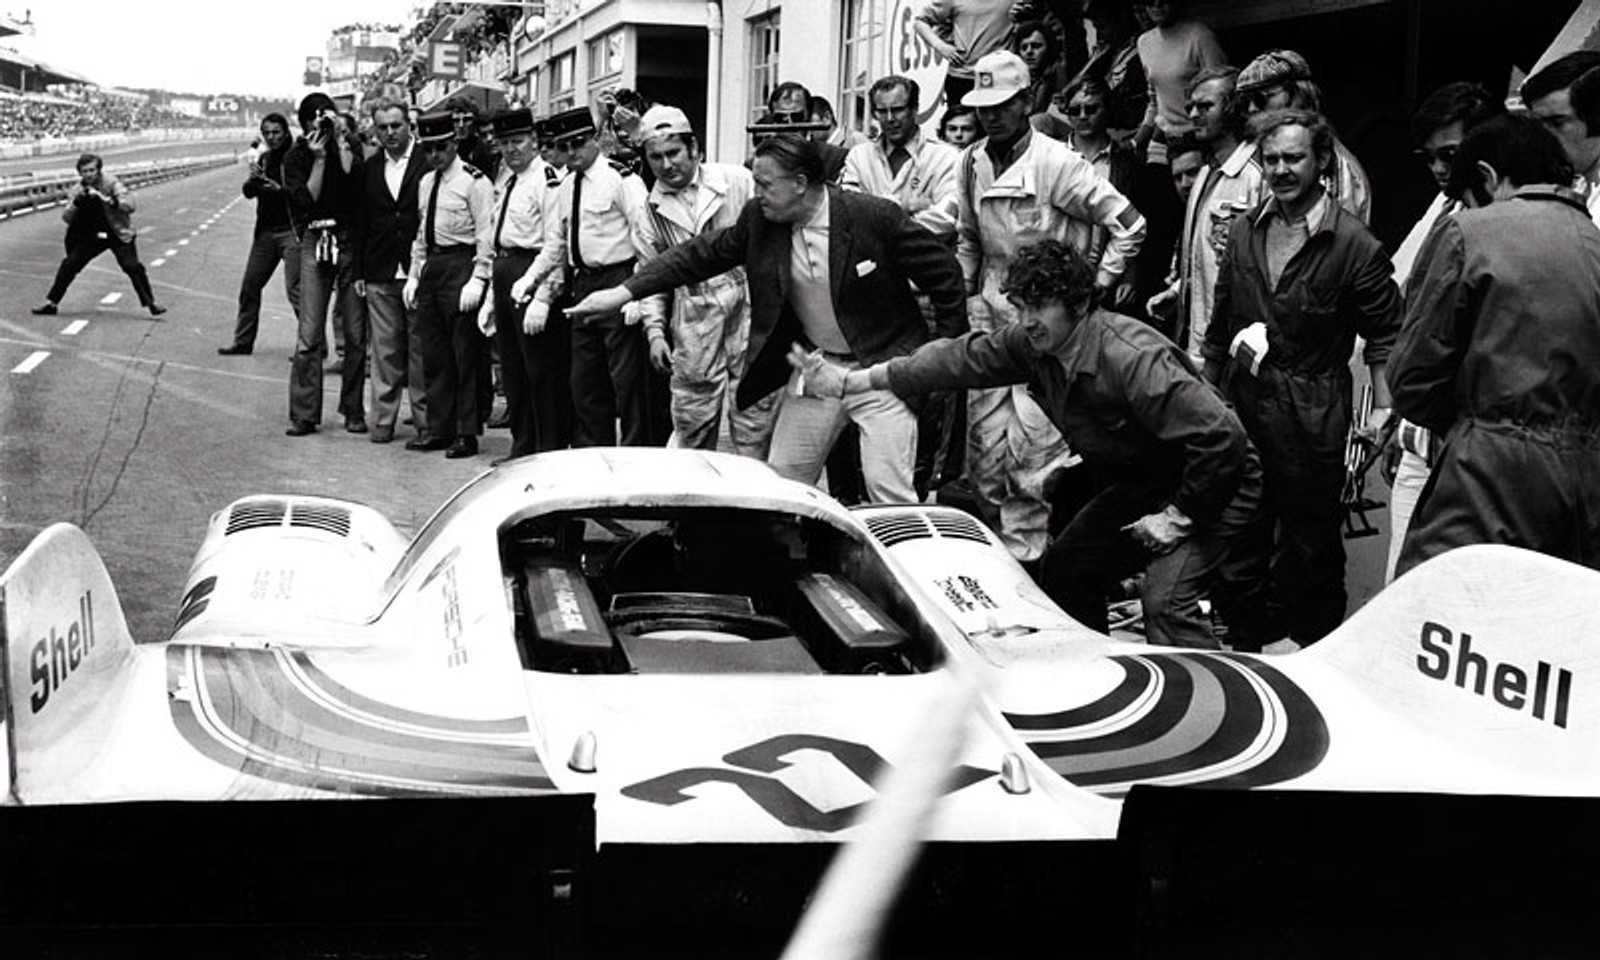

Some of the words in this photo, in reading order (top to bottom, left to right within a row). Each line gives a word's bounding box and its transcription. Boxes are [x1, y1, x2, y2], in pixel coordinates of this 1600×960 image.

[433, 42, 460, 74] E
[30, 589, 94, 715] Shell
[1416, 620, 1573, 730] Shell
